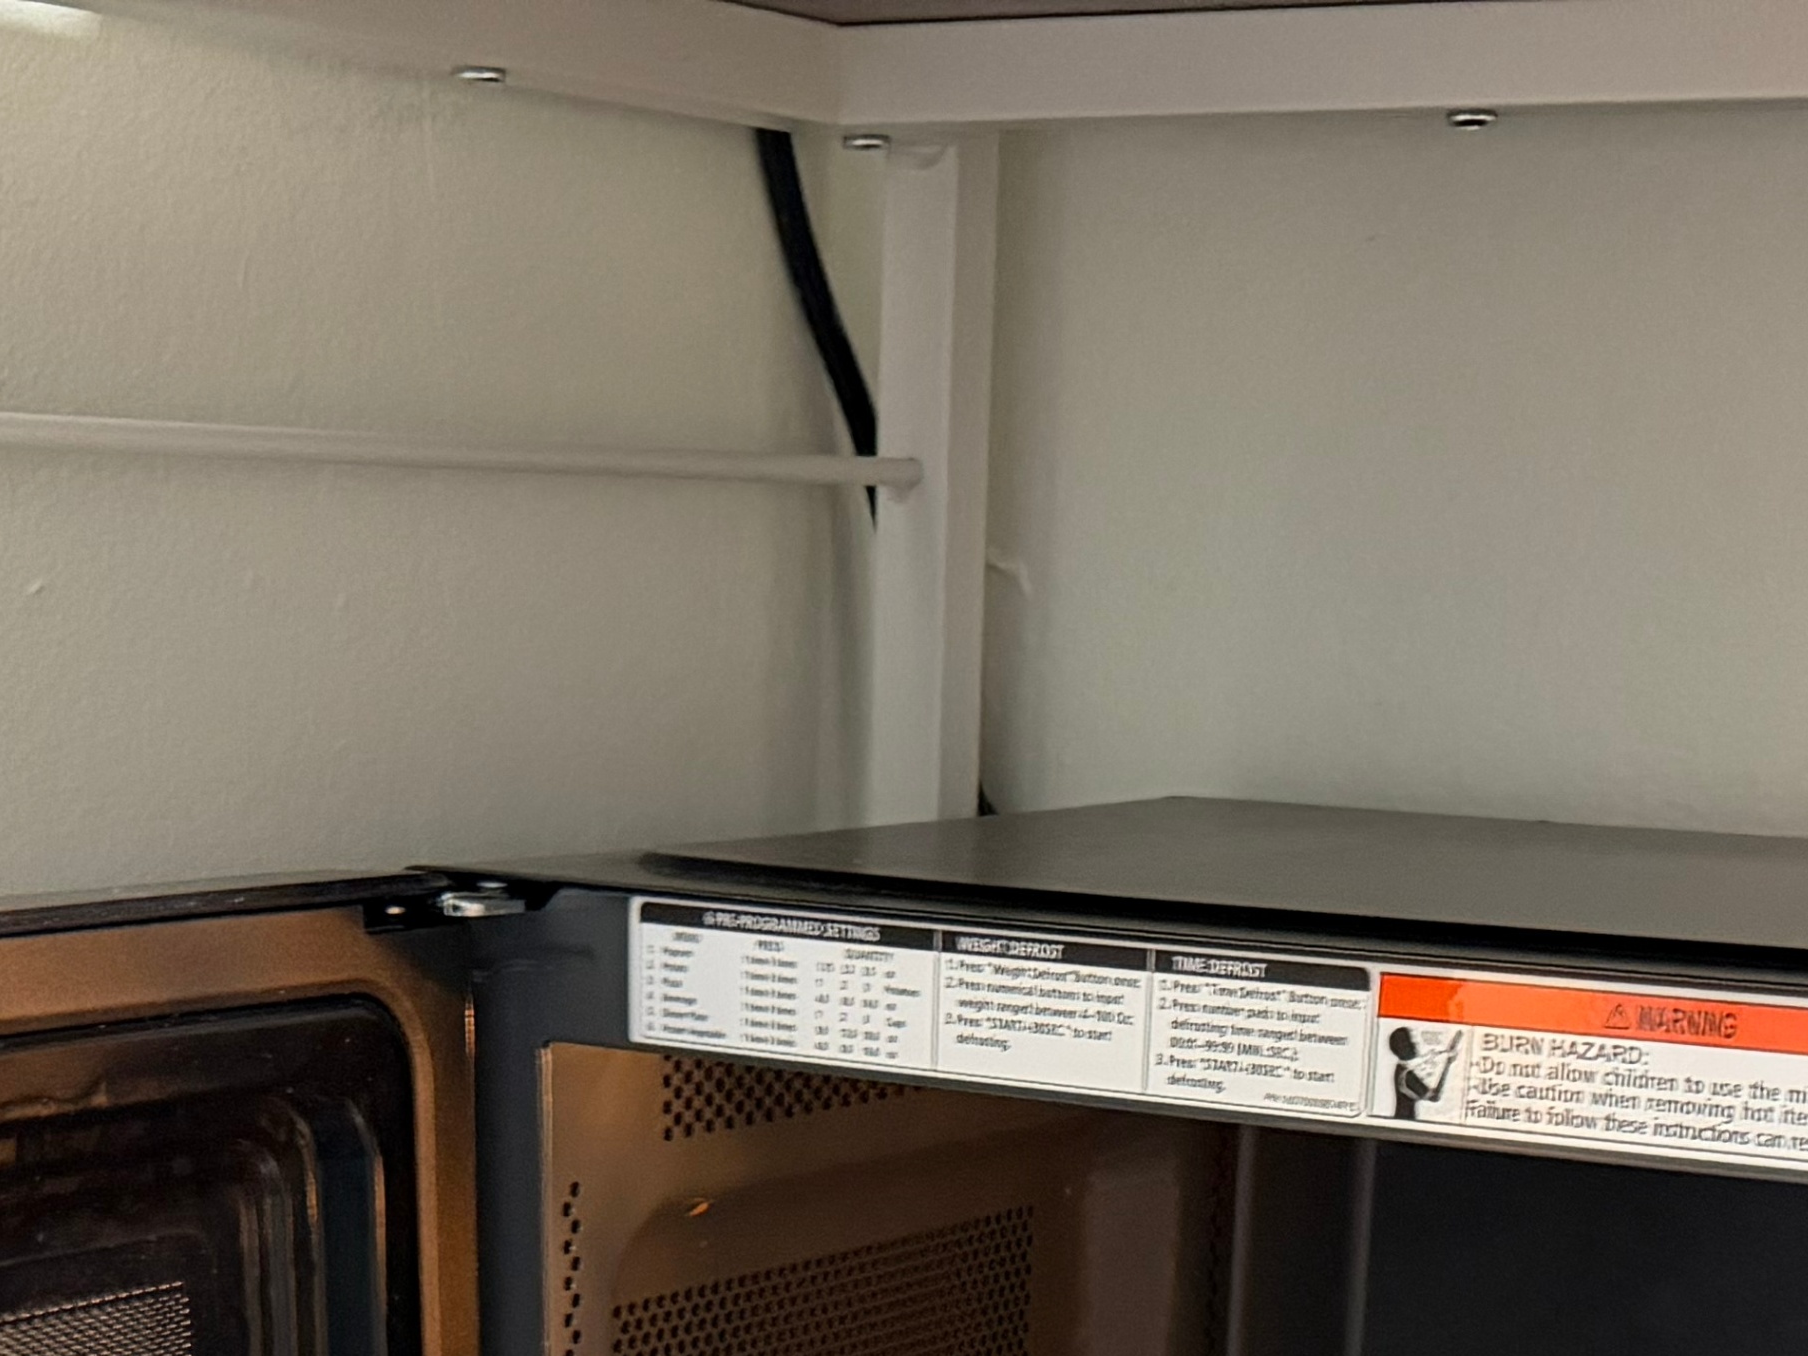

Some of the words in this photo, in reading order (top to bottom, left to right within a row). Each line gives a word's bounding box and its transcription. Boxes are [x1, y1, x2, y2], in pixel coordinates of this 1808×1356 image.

[1637, 1004, 1738, 1039] WARNING
[1481, 1032, 1542, 1056] BURN
[1509, 1058, 1541, 1079] not
[1544, 1060, 1595, 1084] allow
[1603, 1066, 1678, 1092] children
[1684, 1075, 1704, 1095] to
[1711, 1082, 1742, 1099] use
[1748, 1081, 1781, 1103] the
[1516, 1079, 1582, 1104] caution
[1590, 1087, 1640, 1110] when
[1645, 1092, 1736, 1122] removing
[1742, 1102, 1775, 1123] hot
[1464, 1096, 1520, 1122] Failure
[1525, 1103, 1542, 1124] to
[1544, 1105, 1596, 1130] follow
[1602, 1111, 1649, 1135] these
[1653, 1116, 1751, 1145] instructions
[1755, 1131, 1785, 1148] can
